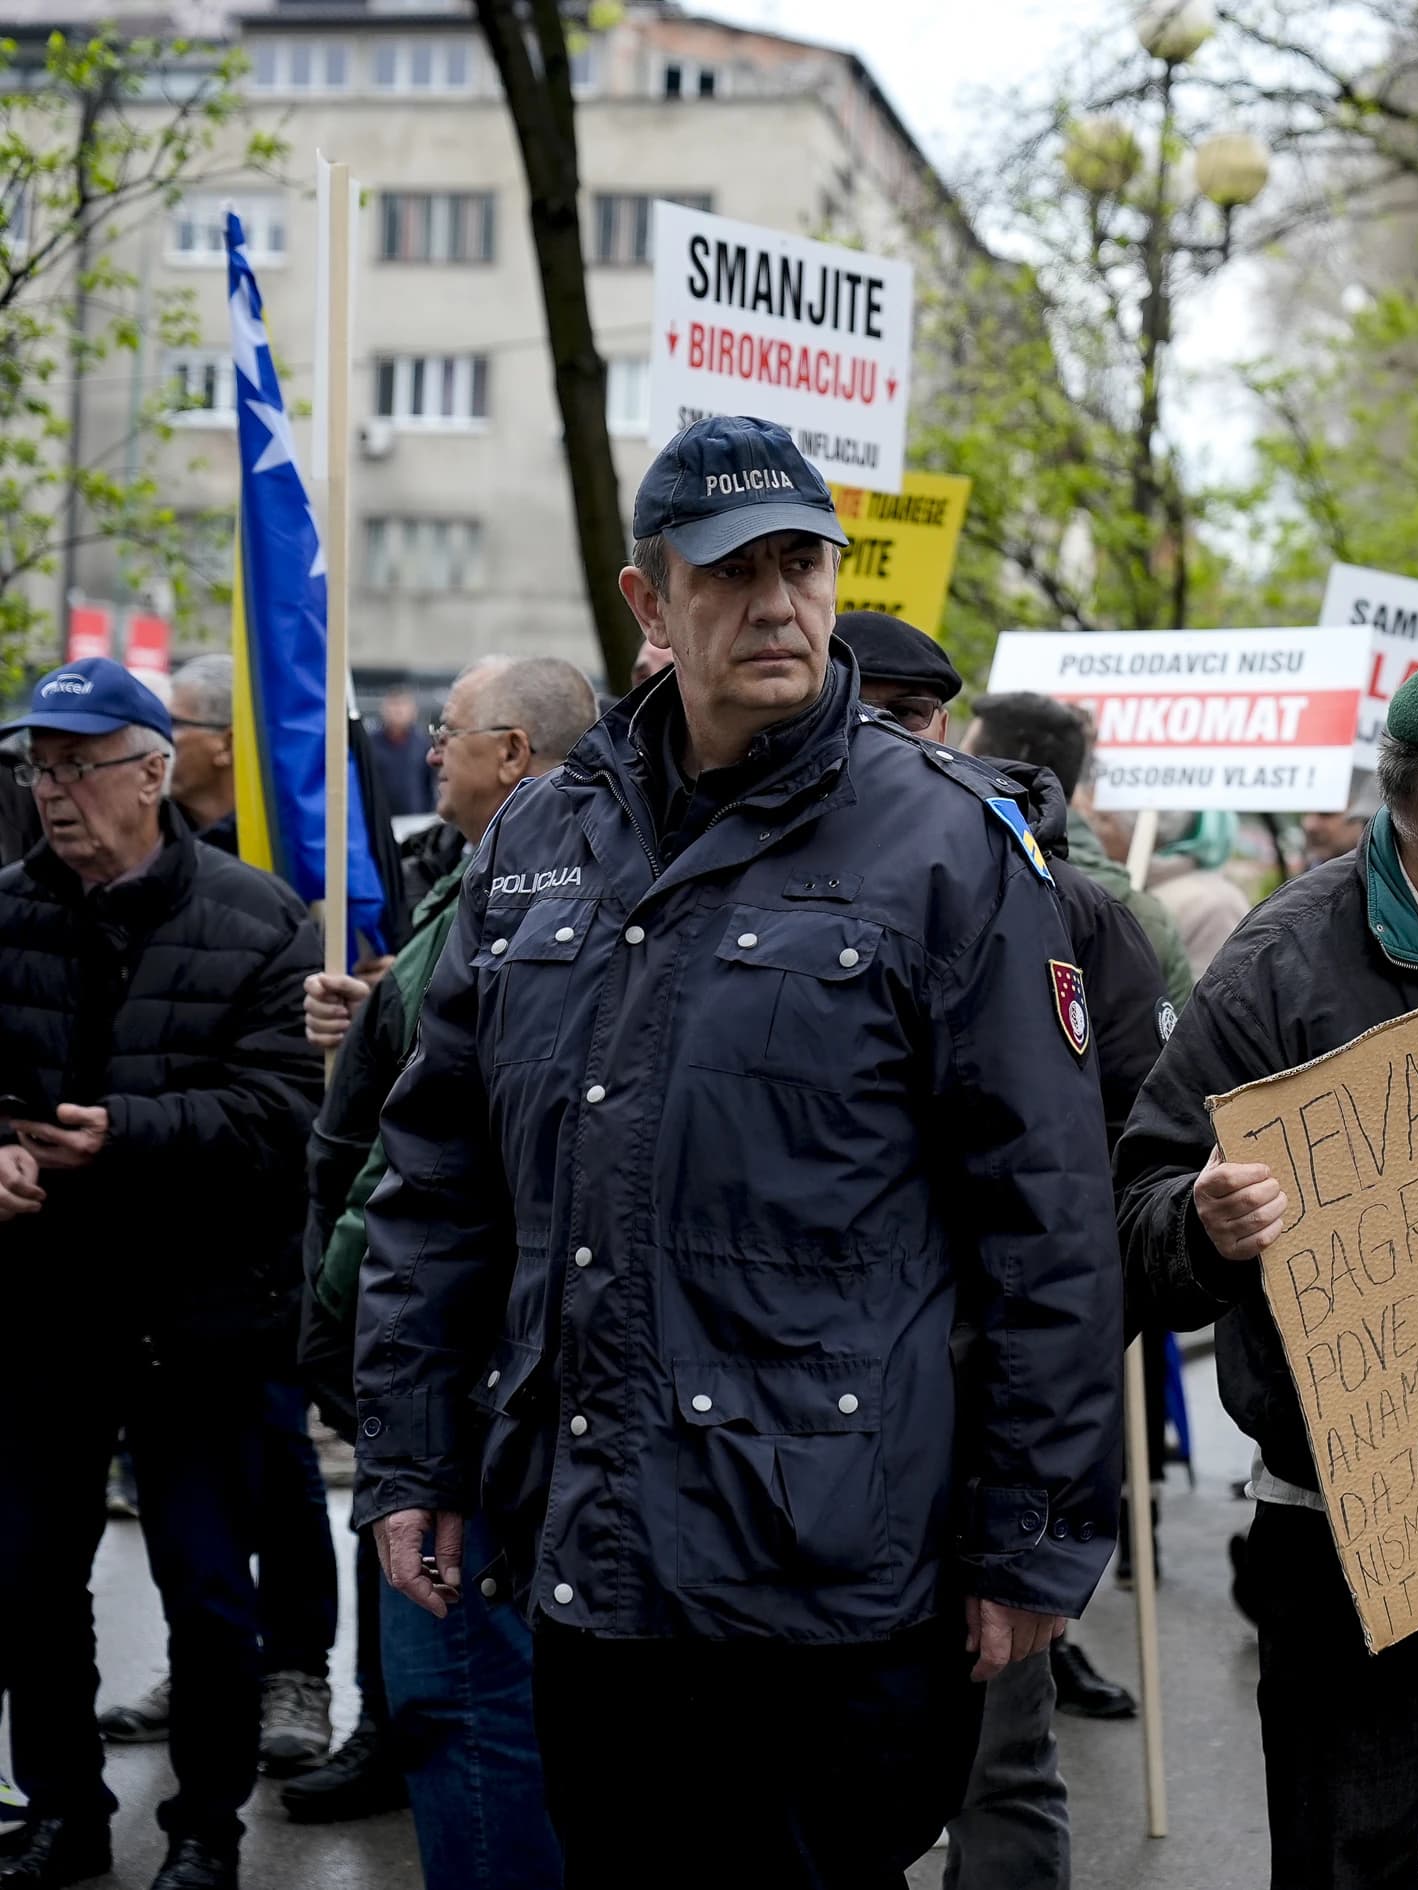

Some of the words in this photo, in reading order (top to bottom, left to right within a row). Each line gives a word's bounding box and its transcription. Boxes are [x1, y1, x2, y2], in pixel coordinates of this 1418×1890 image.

[687, 234, 884, 339] SMANJITE
[688, 321, 878, 404] BIROKRACIJU
[798, 428, 880, 469] INFLACIJU
[705, 468, 795, 497] POLICIJA
[1058, 652, 1228, 676] POSLODAVCI
[1237, 650, 1305, 674] NISU
[1223, 765, 1300, 788] VLAST
[488, 866, 582, 897] POLICIJA
